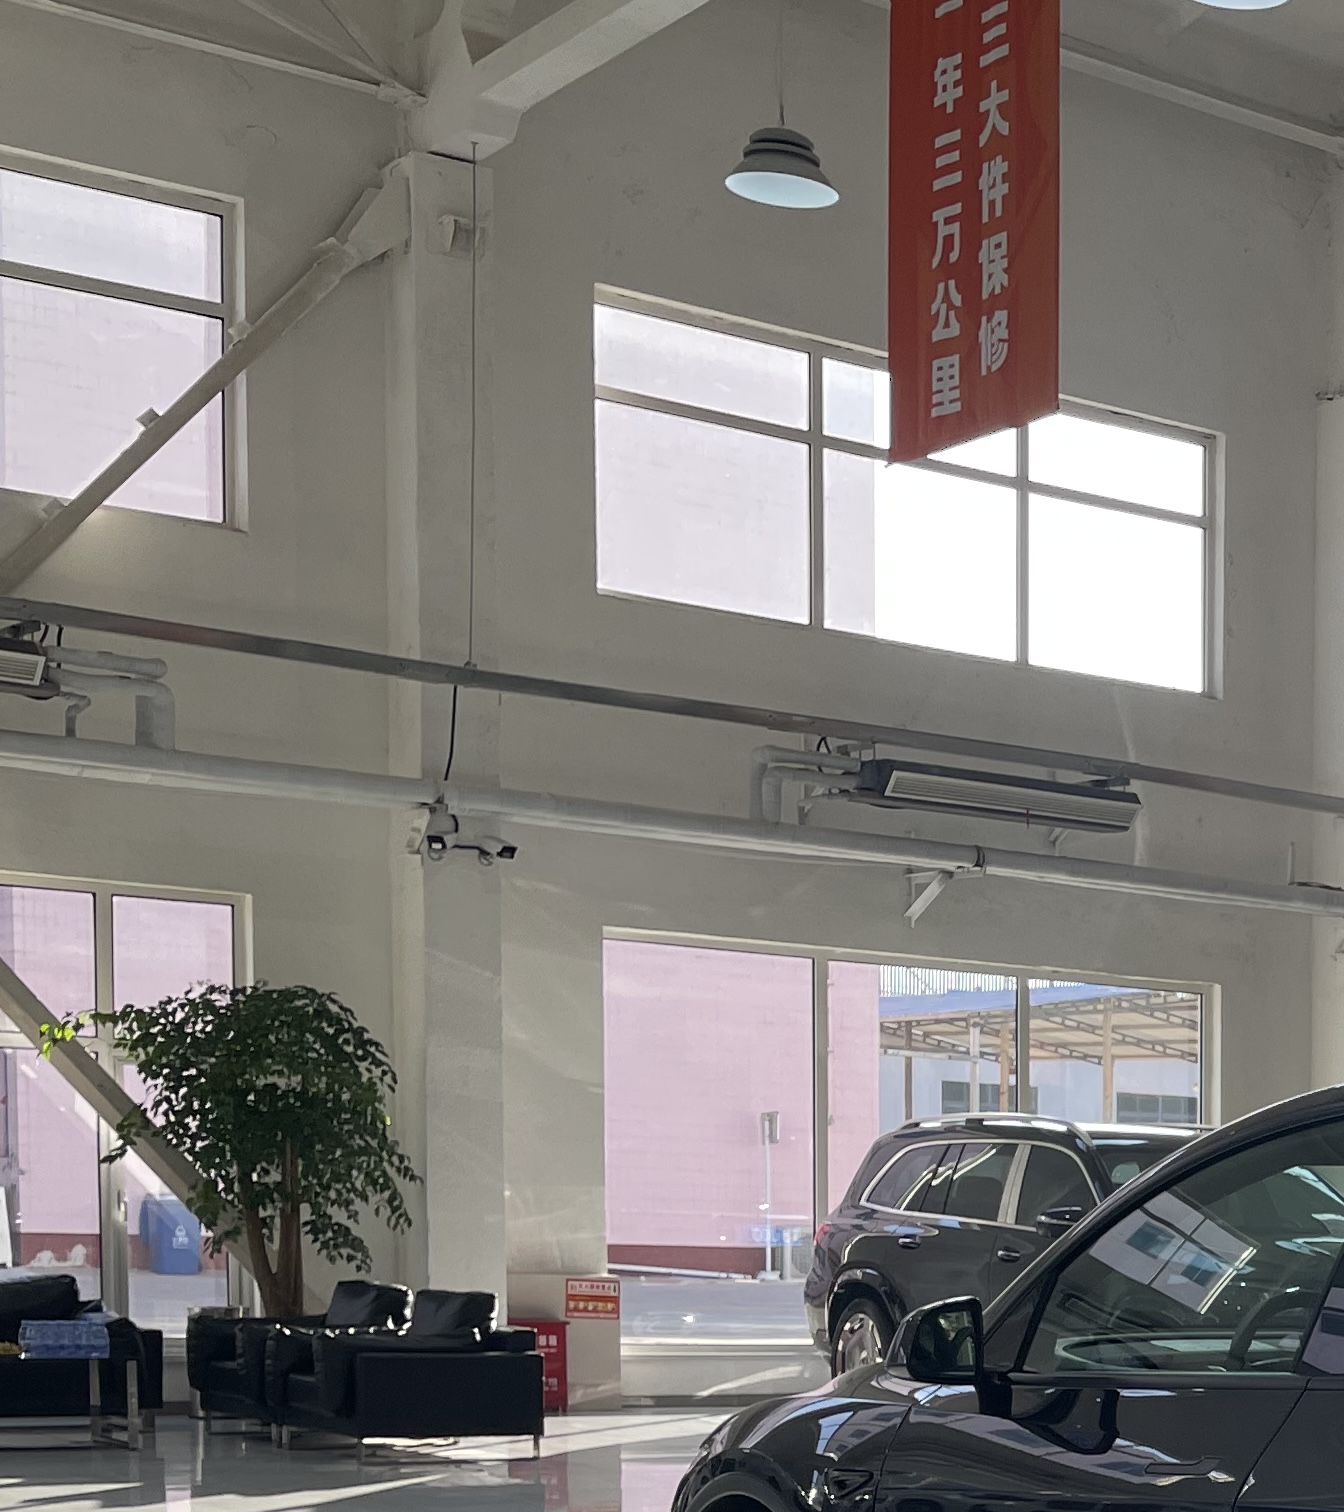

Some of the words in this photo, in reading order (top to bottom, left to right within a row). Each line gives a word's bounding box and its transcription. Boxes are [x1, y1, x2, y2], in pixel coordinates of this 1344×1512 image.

[978, 0, 1010, 377] 三大件保修
